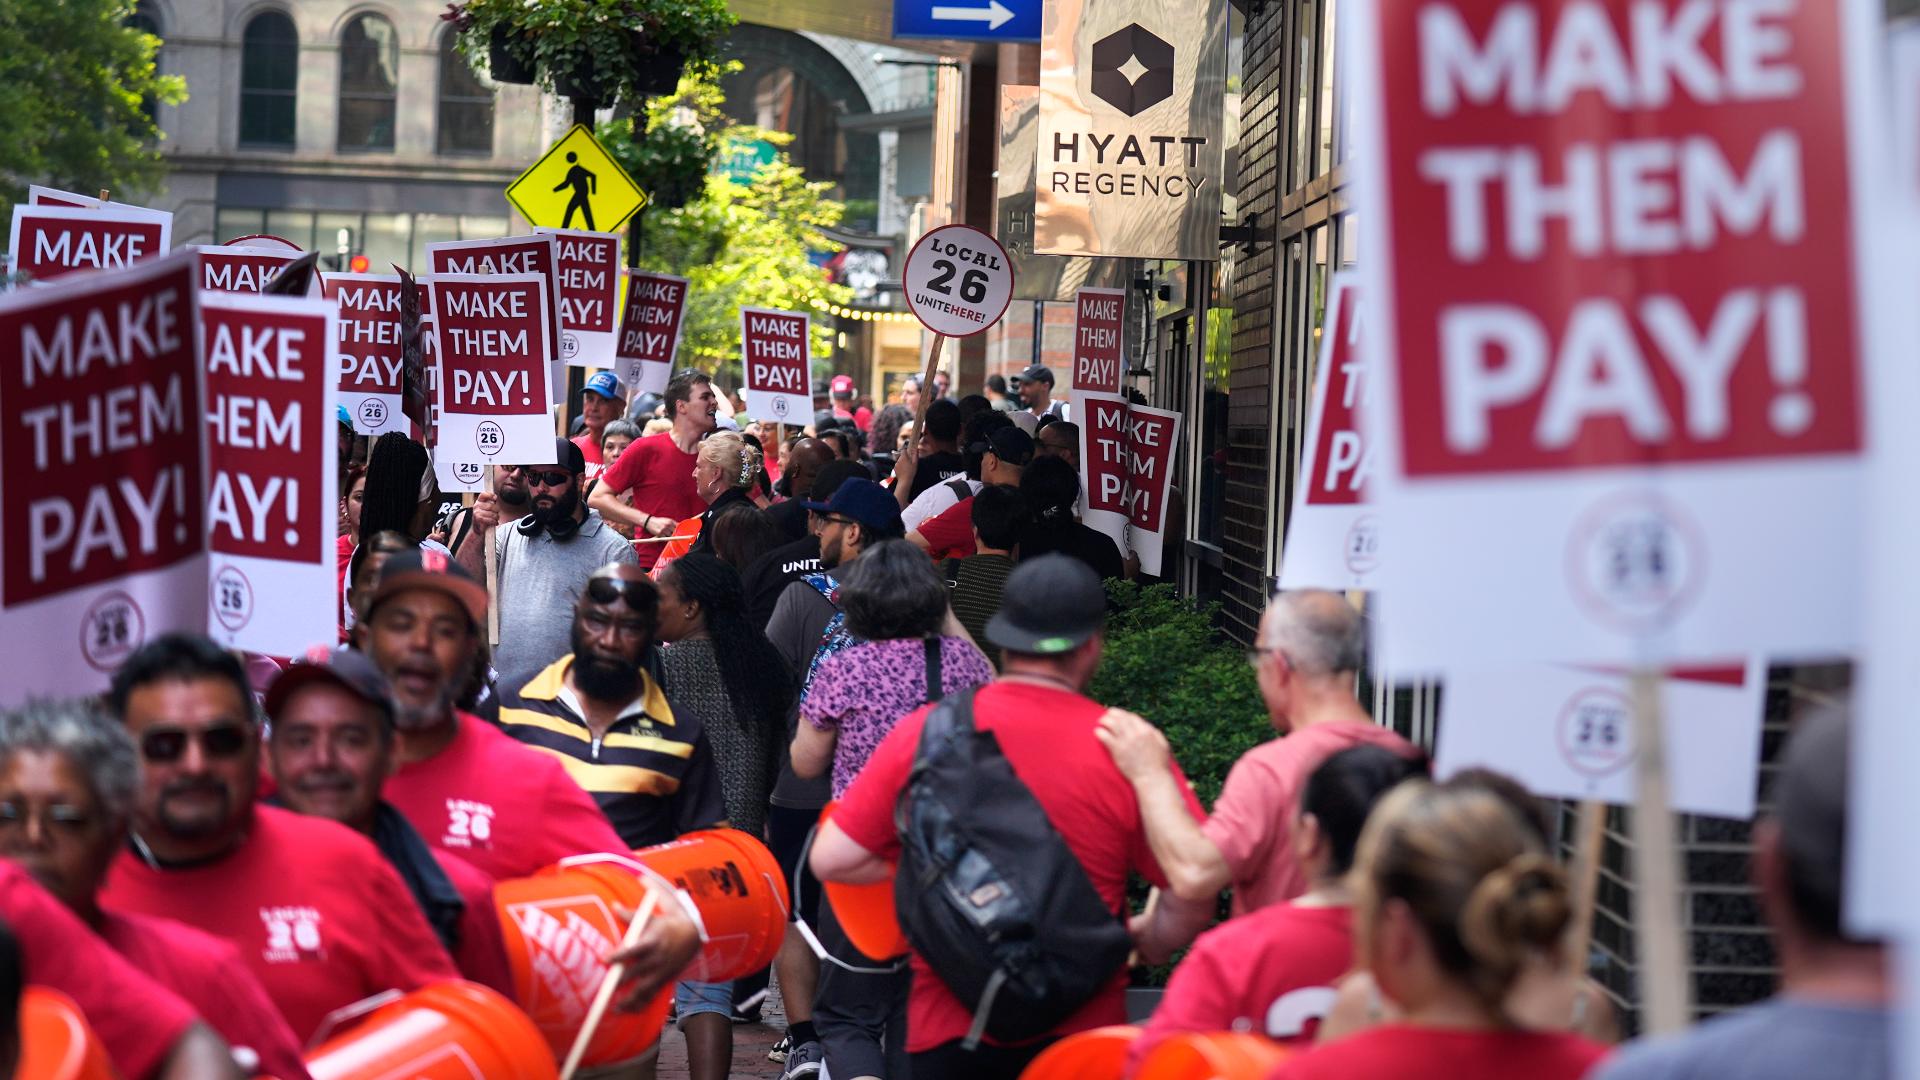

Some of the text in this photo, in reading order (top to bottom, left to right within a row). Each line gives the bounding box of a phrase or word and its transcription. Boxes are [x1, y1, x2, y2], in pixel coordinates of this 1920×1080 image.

[1416, 0, 1803, 117] MAKE
[1053, 132, 1208, 168] HYATT
[1052, 171, 1207, 199] REGENCY
[1417, 127, 1803, 263] THEM
[34, 229, 146, 270] MAKE
[930, 238, 1000, 271] LOCAL
[205, 262, 286, 292] MAK
[559, 268, 605, 290] HEM
[634, 281, 679, 303] MAKE
[926, 259, 990, 304] 26
[338, 287, 402, 312] MAK
[446, 290, 528, 318] MAKE
[561, 297, 602, 326] AY!
[915, 293, 986, 324] UNITEHERE!
[1081, 299, 1118, 321] MAKE
[631, 305, 674, 327] THEM
[751, 317, 801, 339] MAKE
[20, 287, 182, 388] MAKE
[201, 322, 305, 381] AKE
[449, 328, 529, 357] THEM
[623, 330, 668, 357] PAY!
[752, 339, 801, 361] THEM
[1080, 327, 1116, 349] THEM
[338, 353, 403, 387] PAY
[754, 363, 802, 391] PAY!
[1078, 357, 1115, 386] PAY!
[1437, 284, 1815, 455] PAY!
[453, 369, 531, 407] PAY!
[22, 372, 184, 471] THEM
[206, 394, 301, 453] HEM
[365, 408, 382, 418] 26
[480, 433, 498, 444] 26
[460, 463, 479, 473] 26
[208, 470, 299, 546] AY!
[29, 464, 187, 584] PAY!
[449, 810, 491, 840] 26
[267, 919, 321, 951] 26
